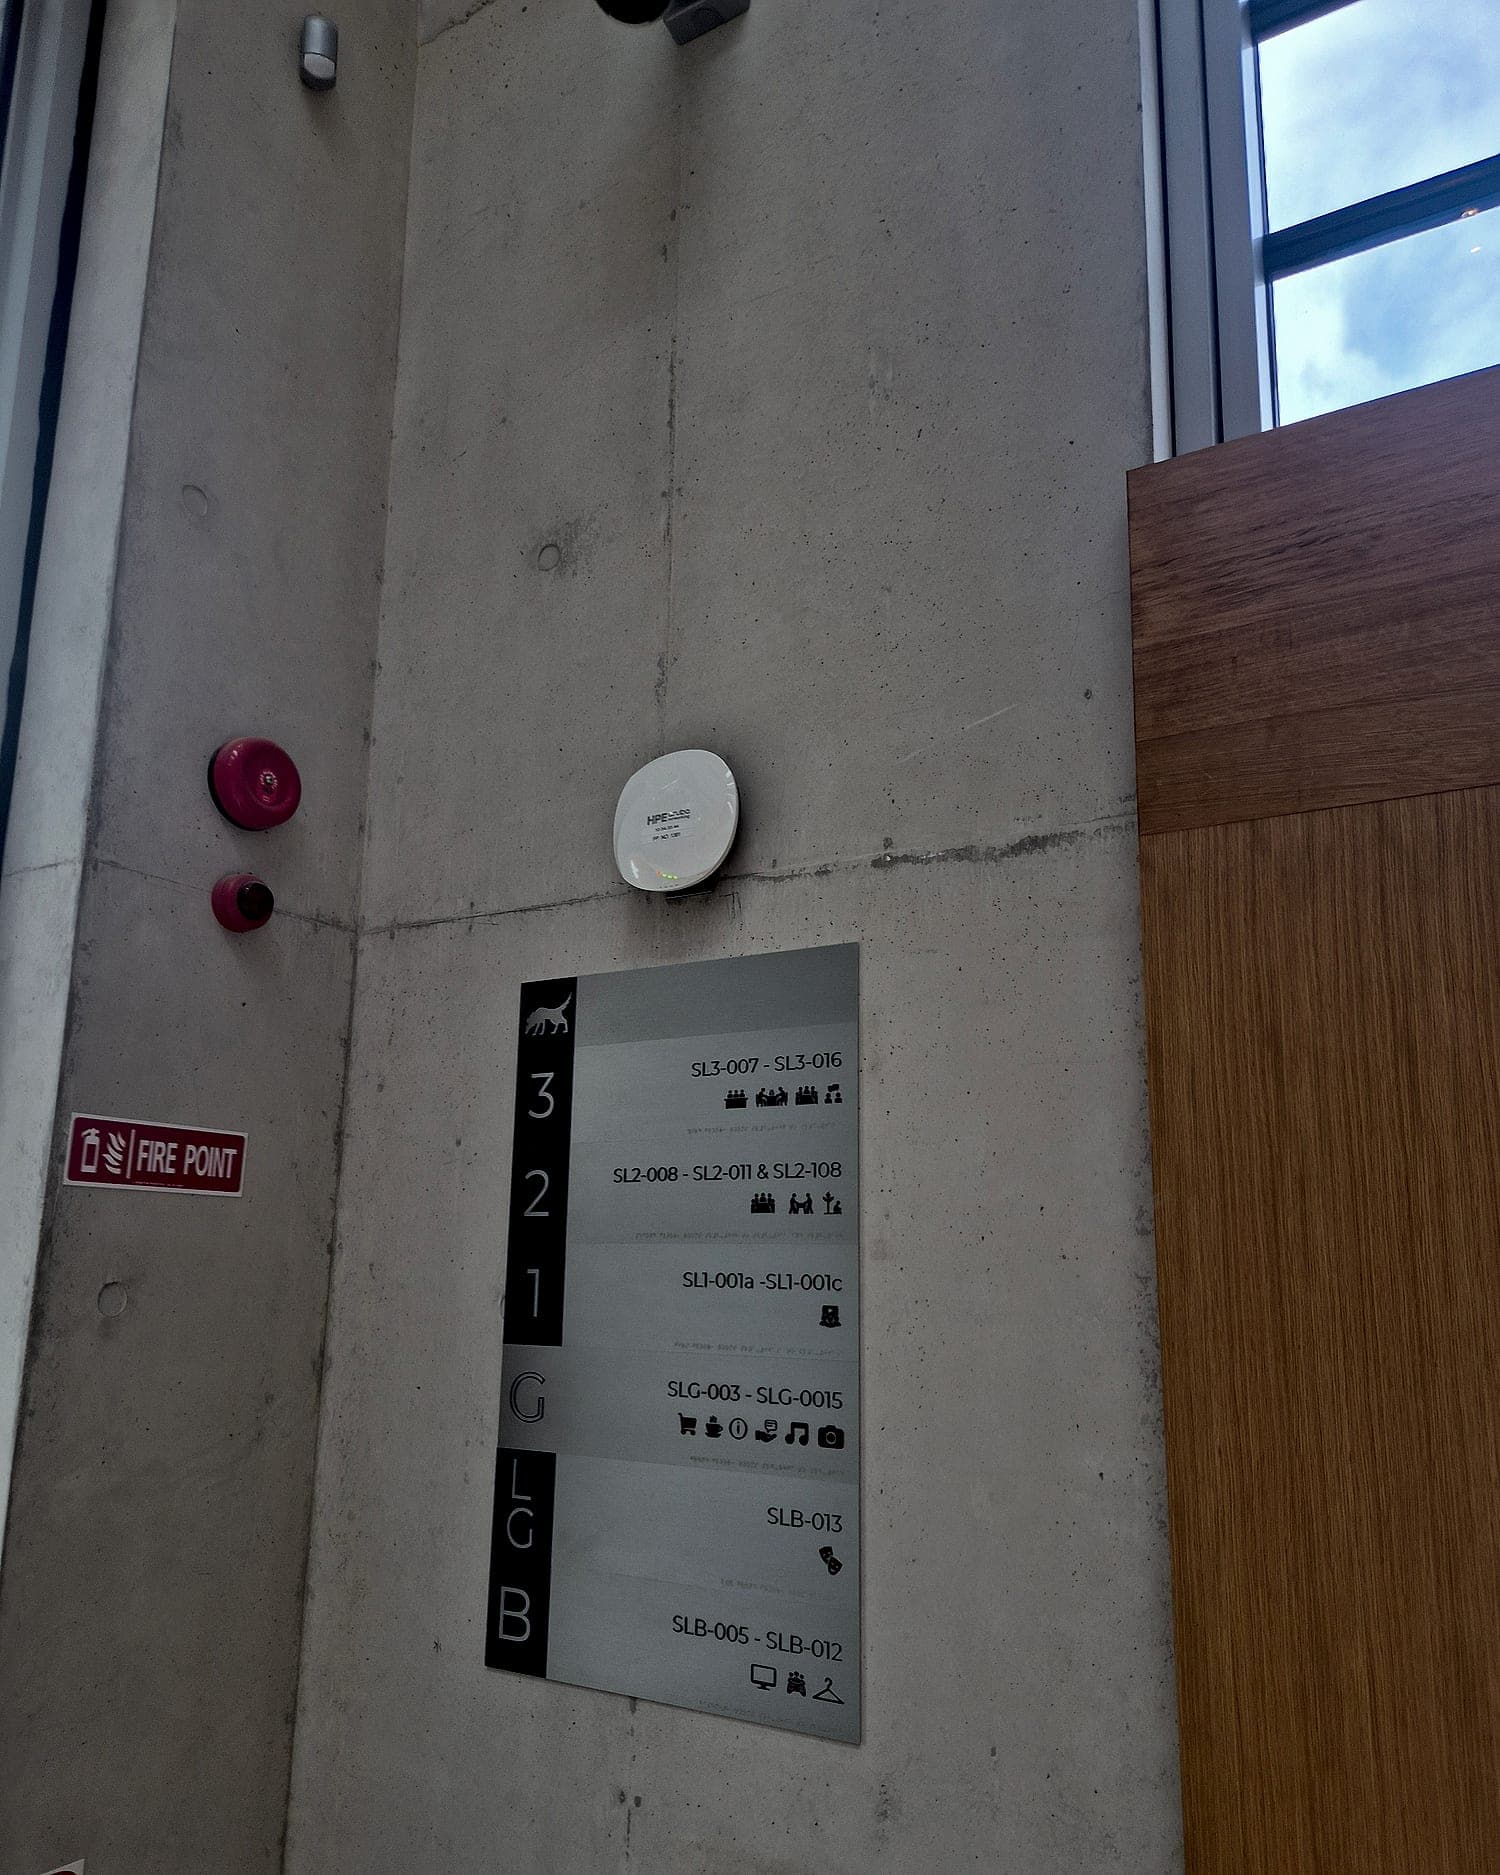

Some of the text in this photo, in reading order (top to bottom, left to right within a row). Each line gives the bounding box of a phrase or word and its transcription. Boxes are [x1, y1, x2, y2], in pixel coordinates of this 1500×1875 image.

[691, 1057, 760, 1078] SL3-007
[774, 1051, 843, 1072] SL3-016
[528, 1071, 555, 1119] 3
[136, 1139, 238, 1179] FIRE POINT
[613, 1166, 679, 1184] SL2-008
[692, 1164, 752, 1182] SL2-011
[756, 1163, 770, 1180] &
[773, 1161, 842, 1180] SL2-108
[523, 1169, 549, 1217] 2
[527, 1268, 540, 1318] 1
[508, 1371, 546, 1424] G
[667, 1380, 741, 1402] SLG-003
[756, 1386, 843, 1410] SLG-0015
[767, 1506, 843, 1533] SLB-013
[498, 1586, 531, 1642] B
[672, 1614, 749, 1645] SLB-005
[766, 1631, 843, 1662] SLB-012
